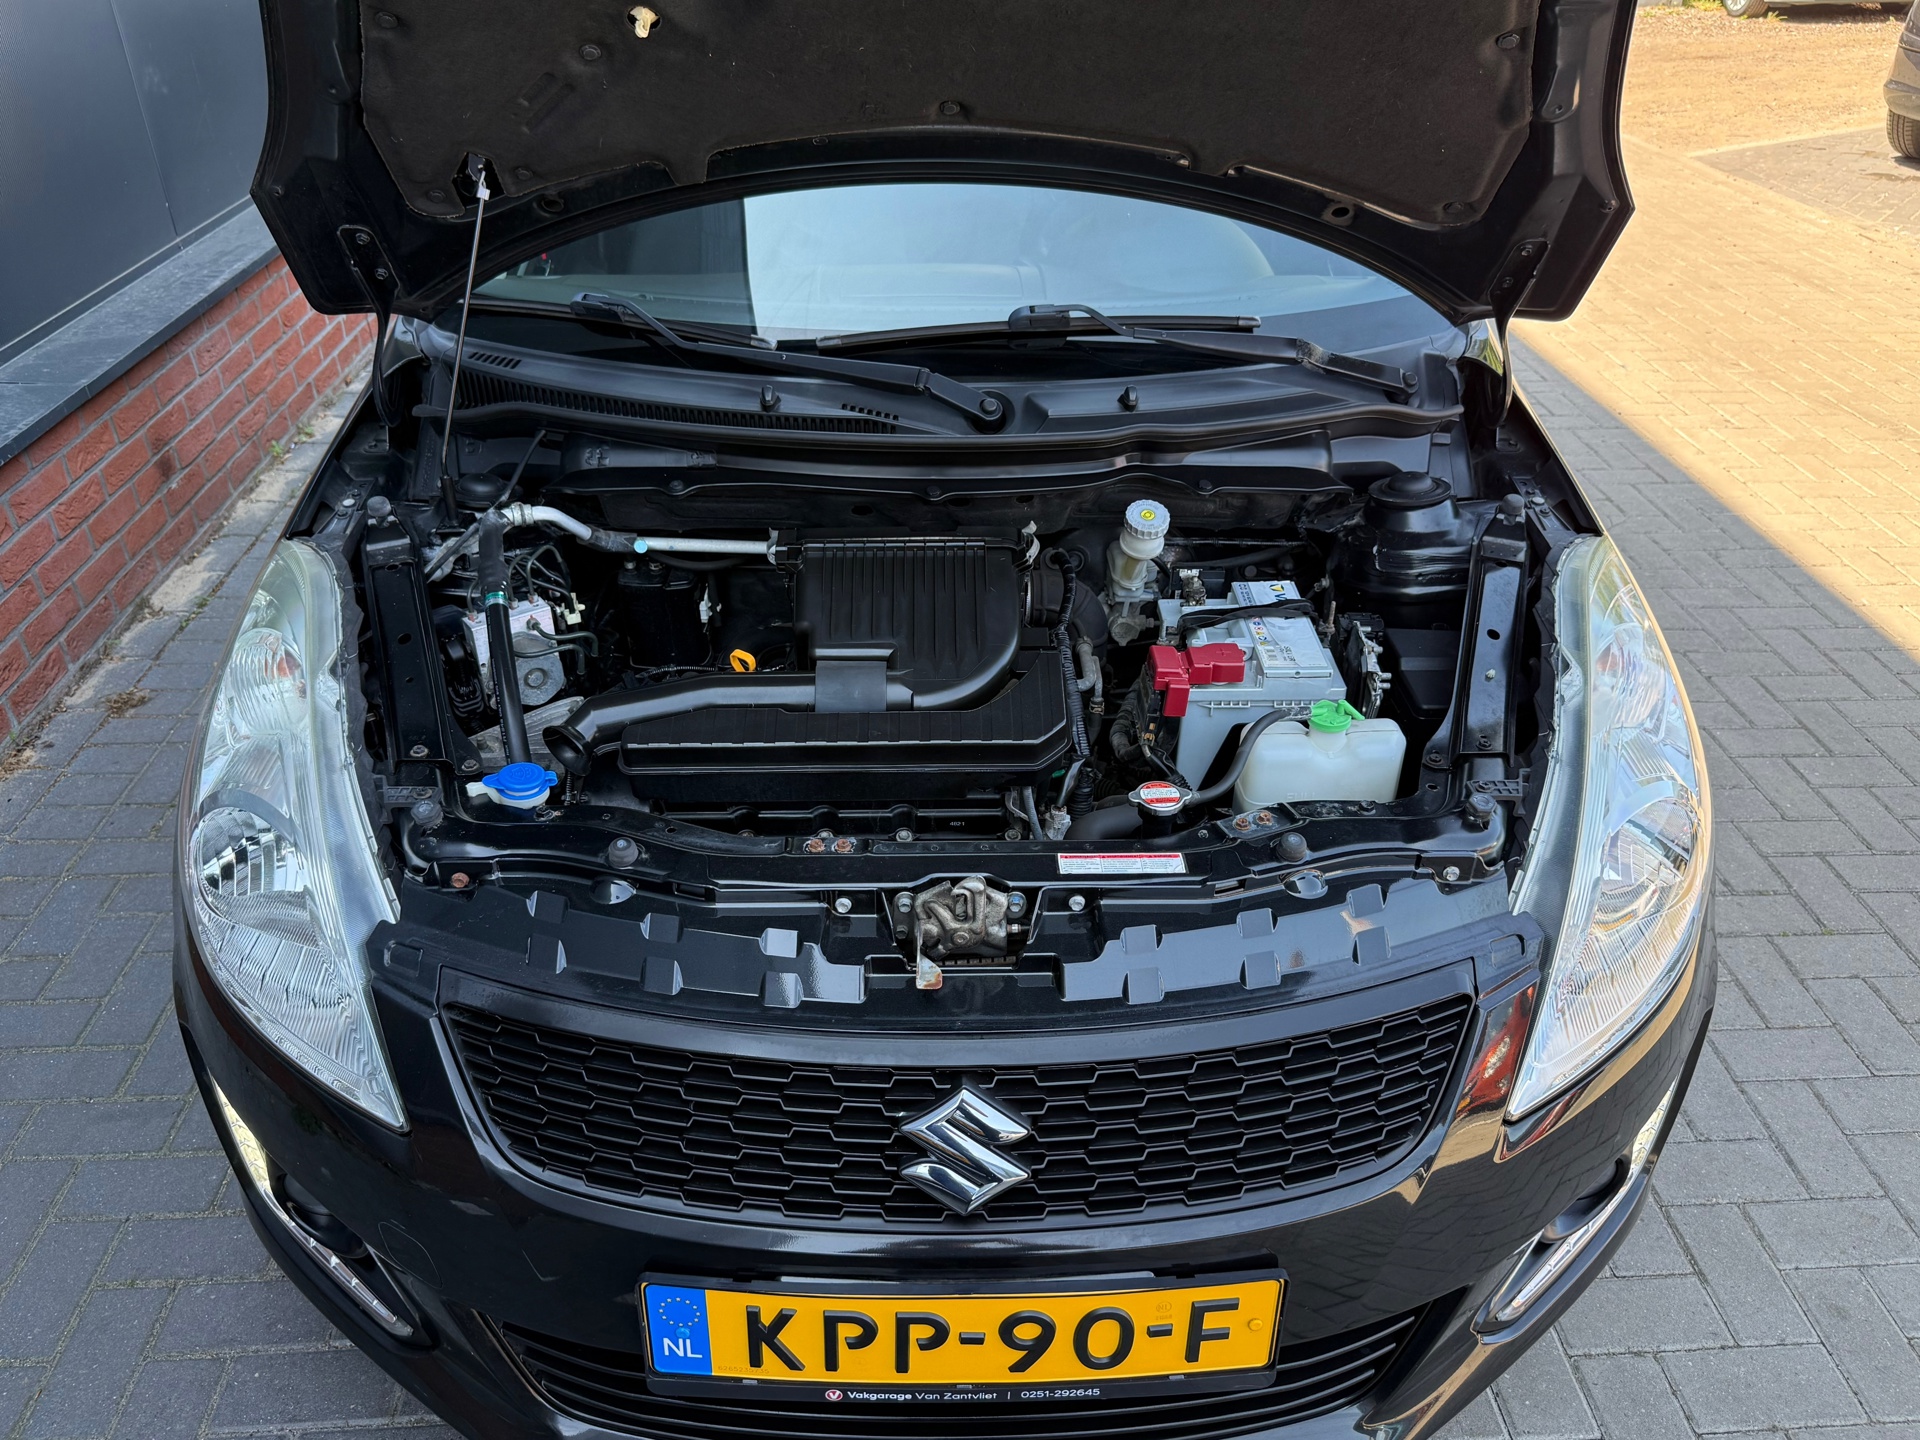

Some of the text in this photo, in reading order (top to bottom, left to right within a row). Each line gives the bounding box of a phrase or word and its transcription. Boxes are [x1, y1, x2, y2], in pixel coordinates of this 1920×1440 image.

[745, 1297, 1240, 1374] KPP-90-F
[661, 1336, 703, 1359] NL
[847, 1391, 912, 1401] Vakgarage
[915, 1391, 940, 1401] Van
[943, 1391, 998, 1400] Zantvliet
[1020, 1388, 1101, 1399] 0251-292645
